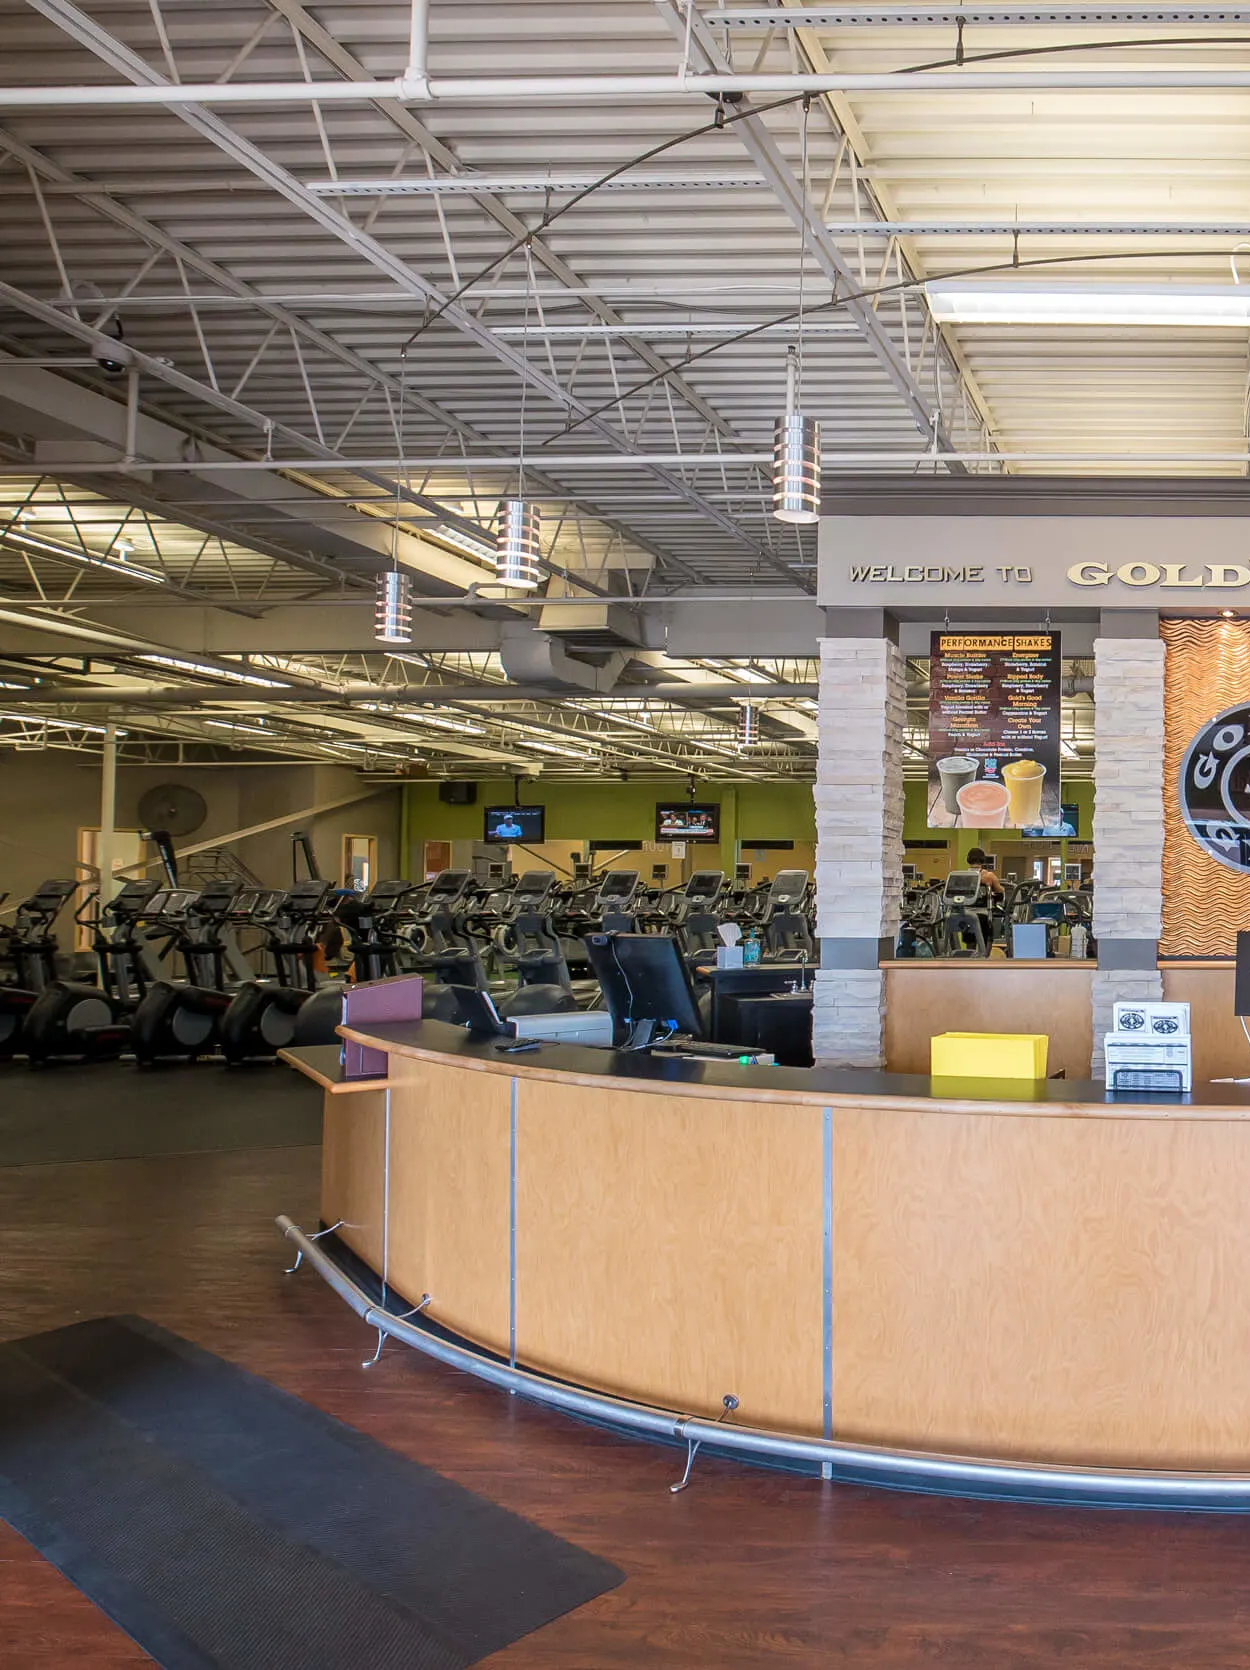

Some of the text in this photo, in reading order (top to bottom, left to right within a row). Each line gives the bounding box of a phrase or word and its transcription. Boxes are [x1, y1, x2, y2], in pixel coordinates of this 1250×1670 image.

[849, 565, 1033, 583] WELCOME TO
[941, 638, 1051, 647] PERFORMANCE SHAKES
